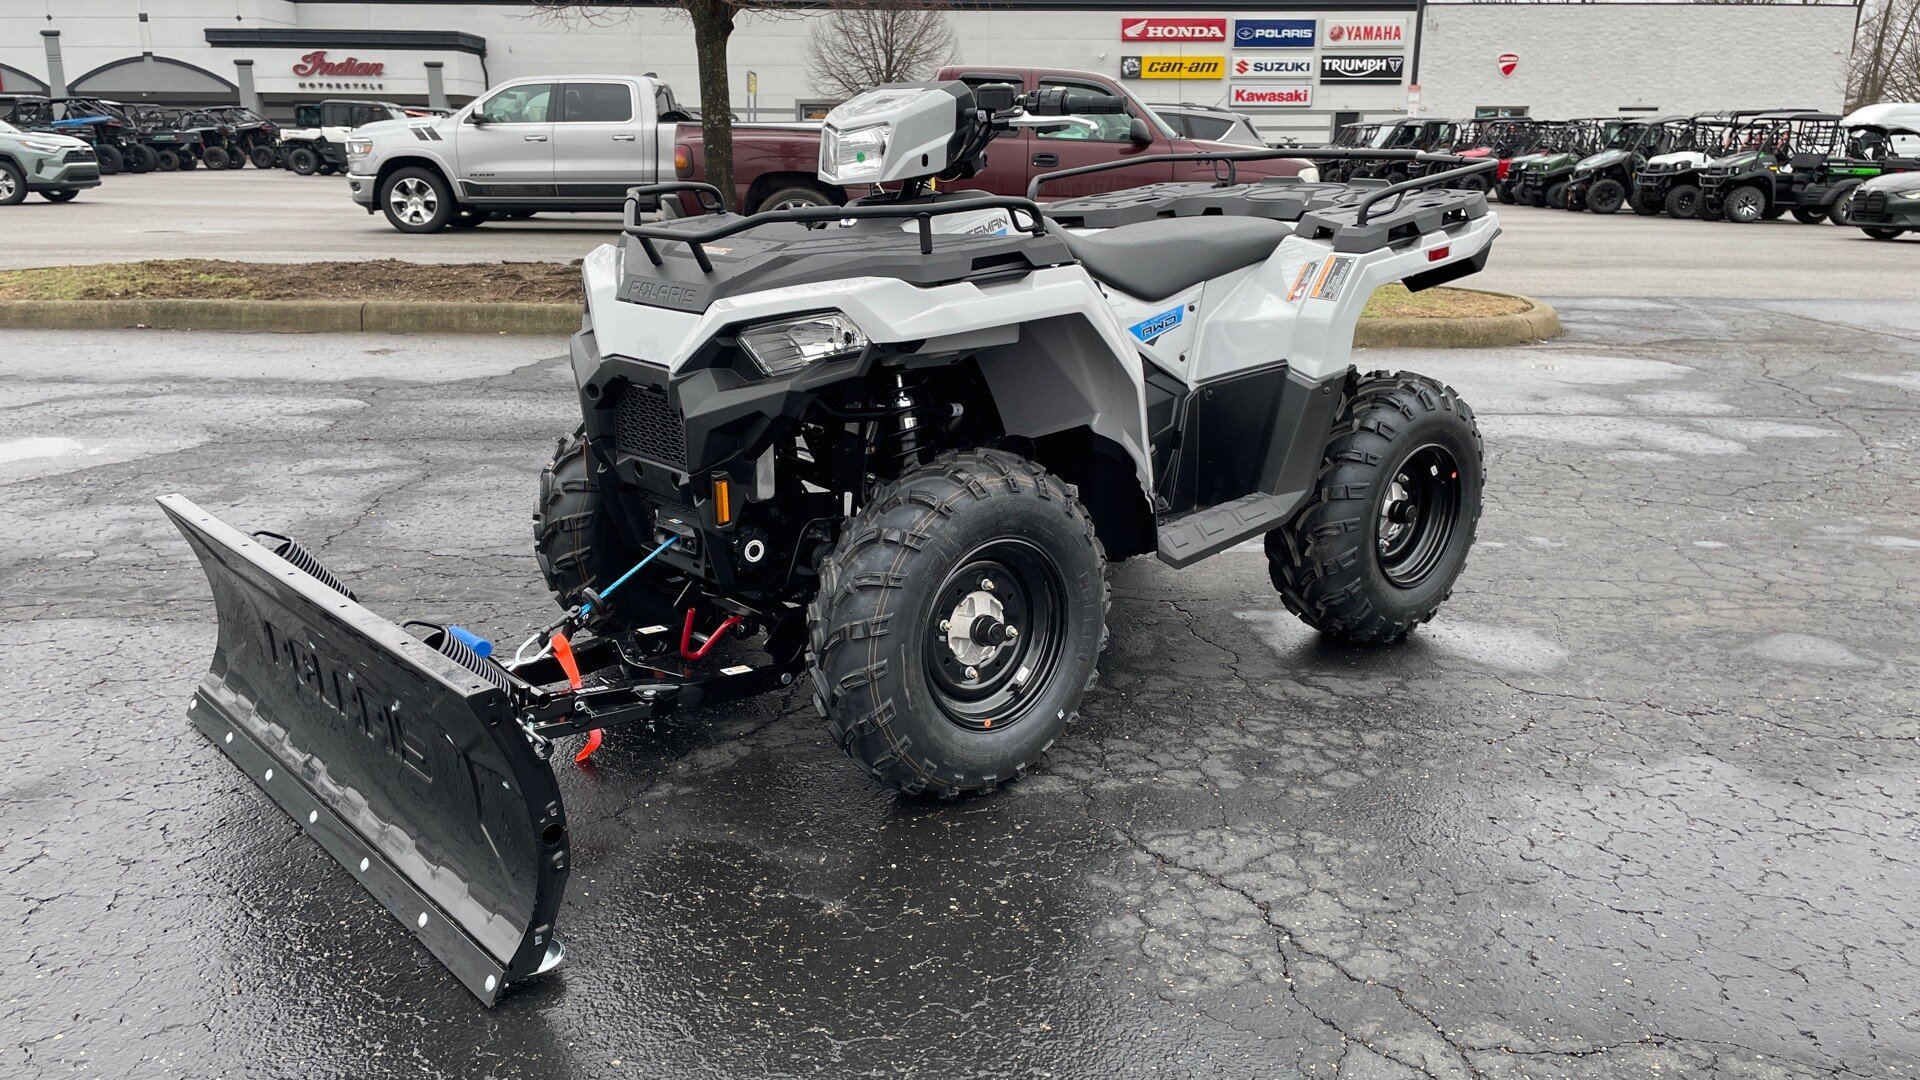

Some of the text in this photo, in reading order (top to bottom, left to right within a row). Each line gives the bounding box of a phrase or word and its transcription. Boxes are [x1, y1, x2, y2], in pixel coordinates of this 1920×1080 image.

[1147, 26, 1224, 38] HONDA
[1255, 29, 1312, 38] POLARIS
[1345, 26, 1401, 41] YAMAHA
[292, 51, 385, 77] Indian
[1148, 61, 1219, 73] can-am
[1253, 62, 1311, 72] SUZUKI
[1322, 58, 1387, 76] TRIUMPH
[298, 82, 384, 90] MOTORCYCLE
[1235, 89, 1309, 102] Kawasaki
[628, 280, 697, 304] POLARIS
[1142, 315, 1177, 338] AWD
